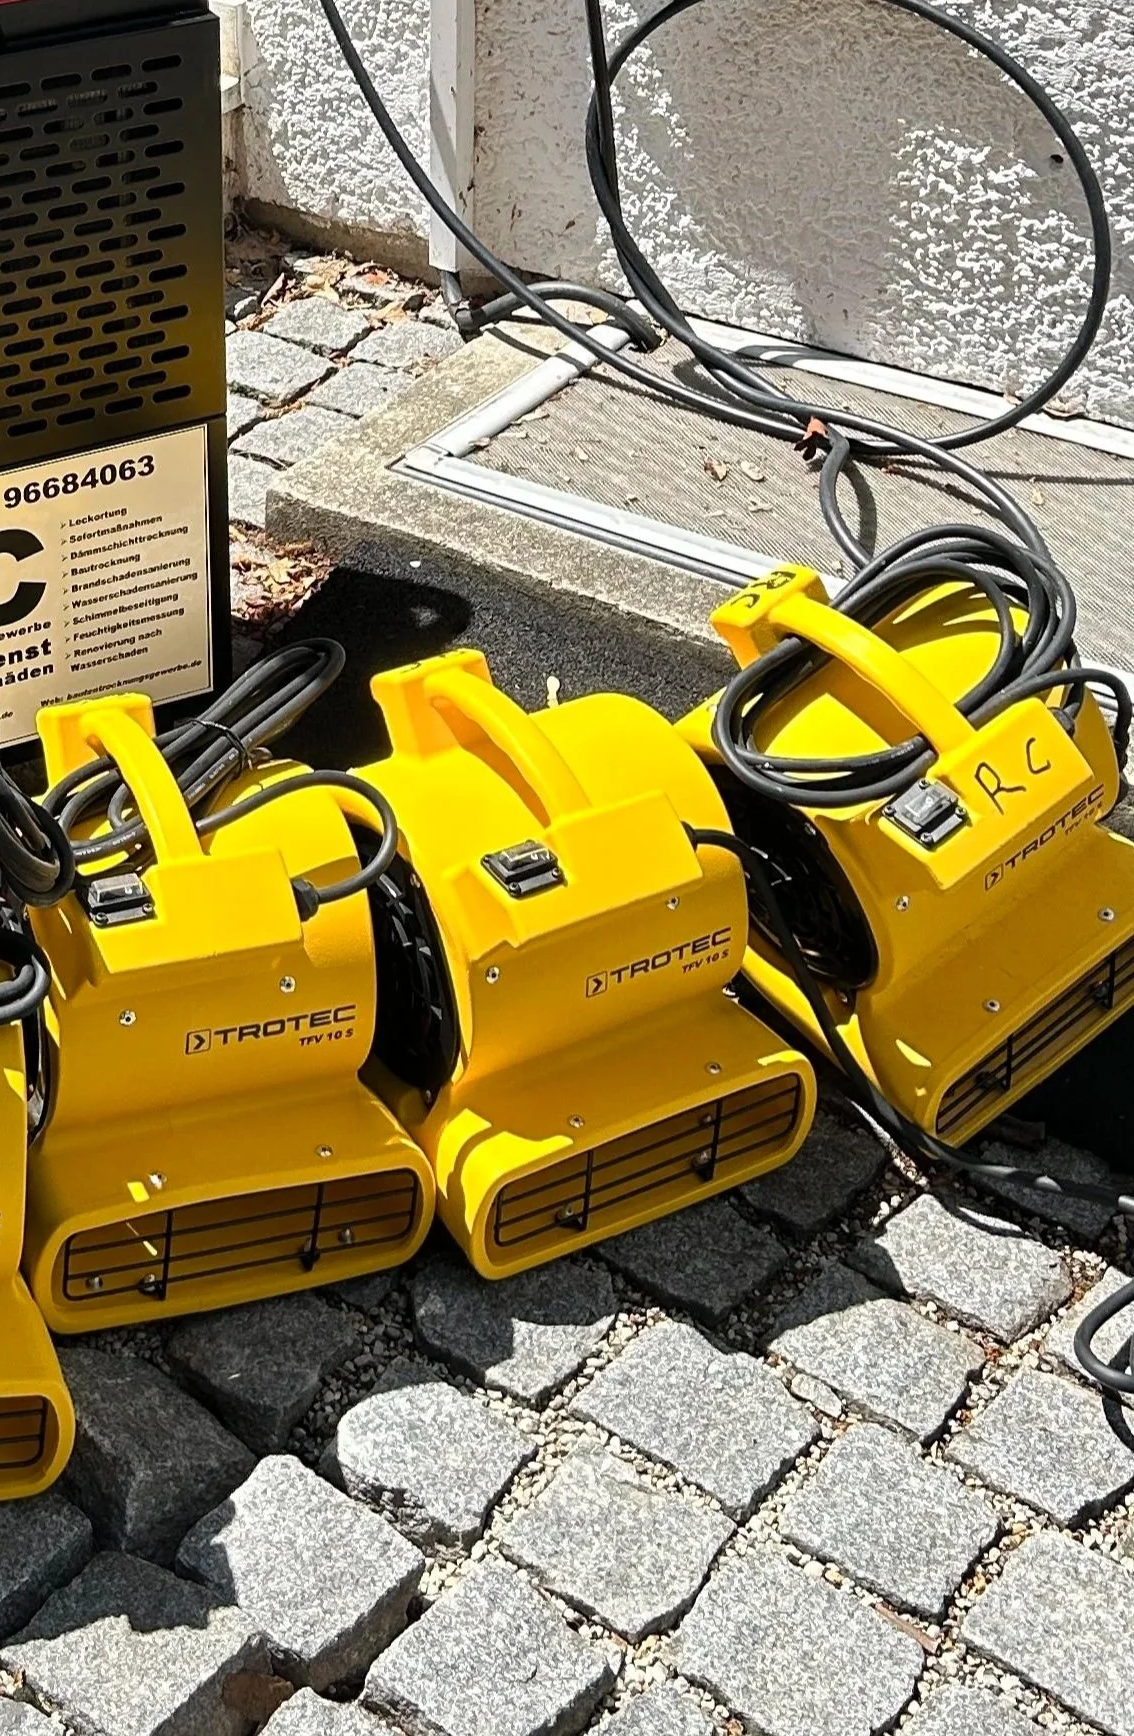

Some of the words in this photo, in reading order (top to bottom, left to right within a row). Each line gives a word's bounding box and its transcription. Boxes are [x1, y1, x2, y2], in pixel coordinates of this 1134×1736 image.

[3, 454, 156, 509] 96684063
[69, 507, 128, 527] Leckortung
[69, 515, 163, 544] Sofortmaßnahmen
[70, 525, 189, 560] Dämmschichttrocknung
[71, 553, 141, 576] Bautrocknung
[71, 557, 191, 593] Brandschadensanierung
[72, 572, 198, 609] Wasserschadensanierung
[72, 592, 179, 626] Schimmelbeseitigung
[73, 606, 185, 642] Feuchtigkeitsmessung
[70, 646, 149, 672] Wasserschaden
[73, 636, 136, 658] Renovierung
[138, 628, 163, 641] nach
[1005, 783, 1105, 869] TROTEC
[609, 927, 732, 984] TROTEC
[681, 959, 704, 975] TFV
[705, 952, 720, 965] 10
[721, 948, 729, 958] S
[213, 1004, 356, 1045] TROTEC
[299, 1034, 325, 1047] TFV
[327, 1030, 342, 1041] 10
[344, 1028, 354, 1038] S
